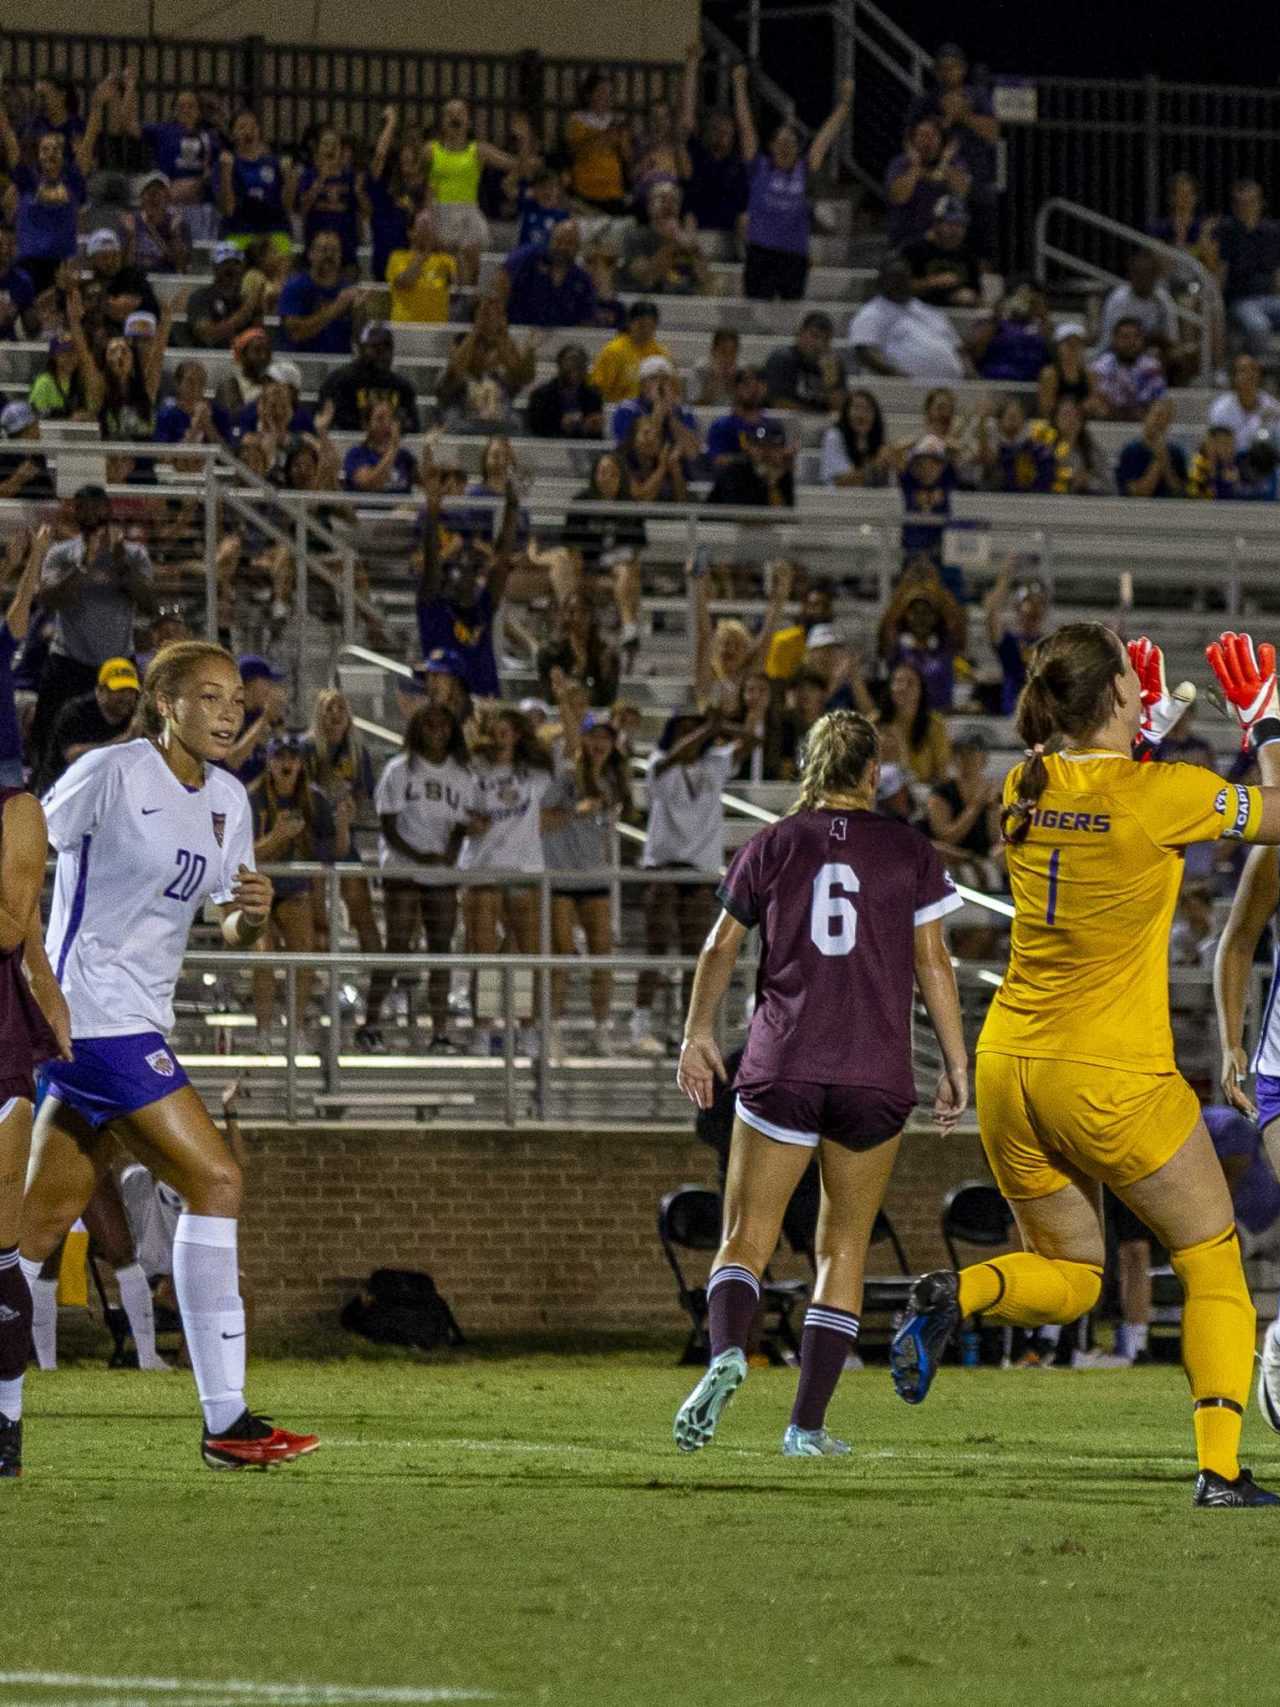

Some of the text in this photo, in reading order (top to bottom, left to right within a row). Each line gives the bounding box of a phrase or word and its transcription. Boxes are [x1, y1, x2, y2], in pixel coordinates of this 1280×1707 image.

[1032, 808, 1111, 833] IGERS
[163, 849, 207, 902] 20
[1046, 848, 1060, 926] 1
[811, 863, 860, 956] 6
